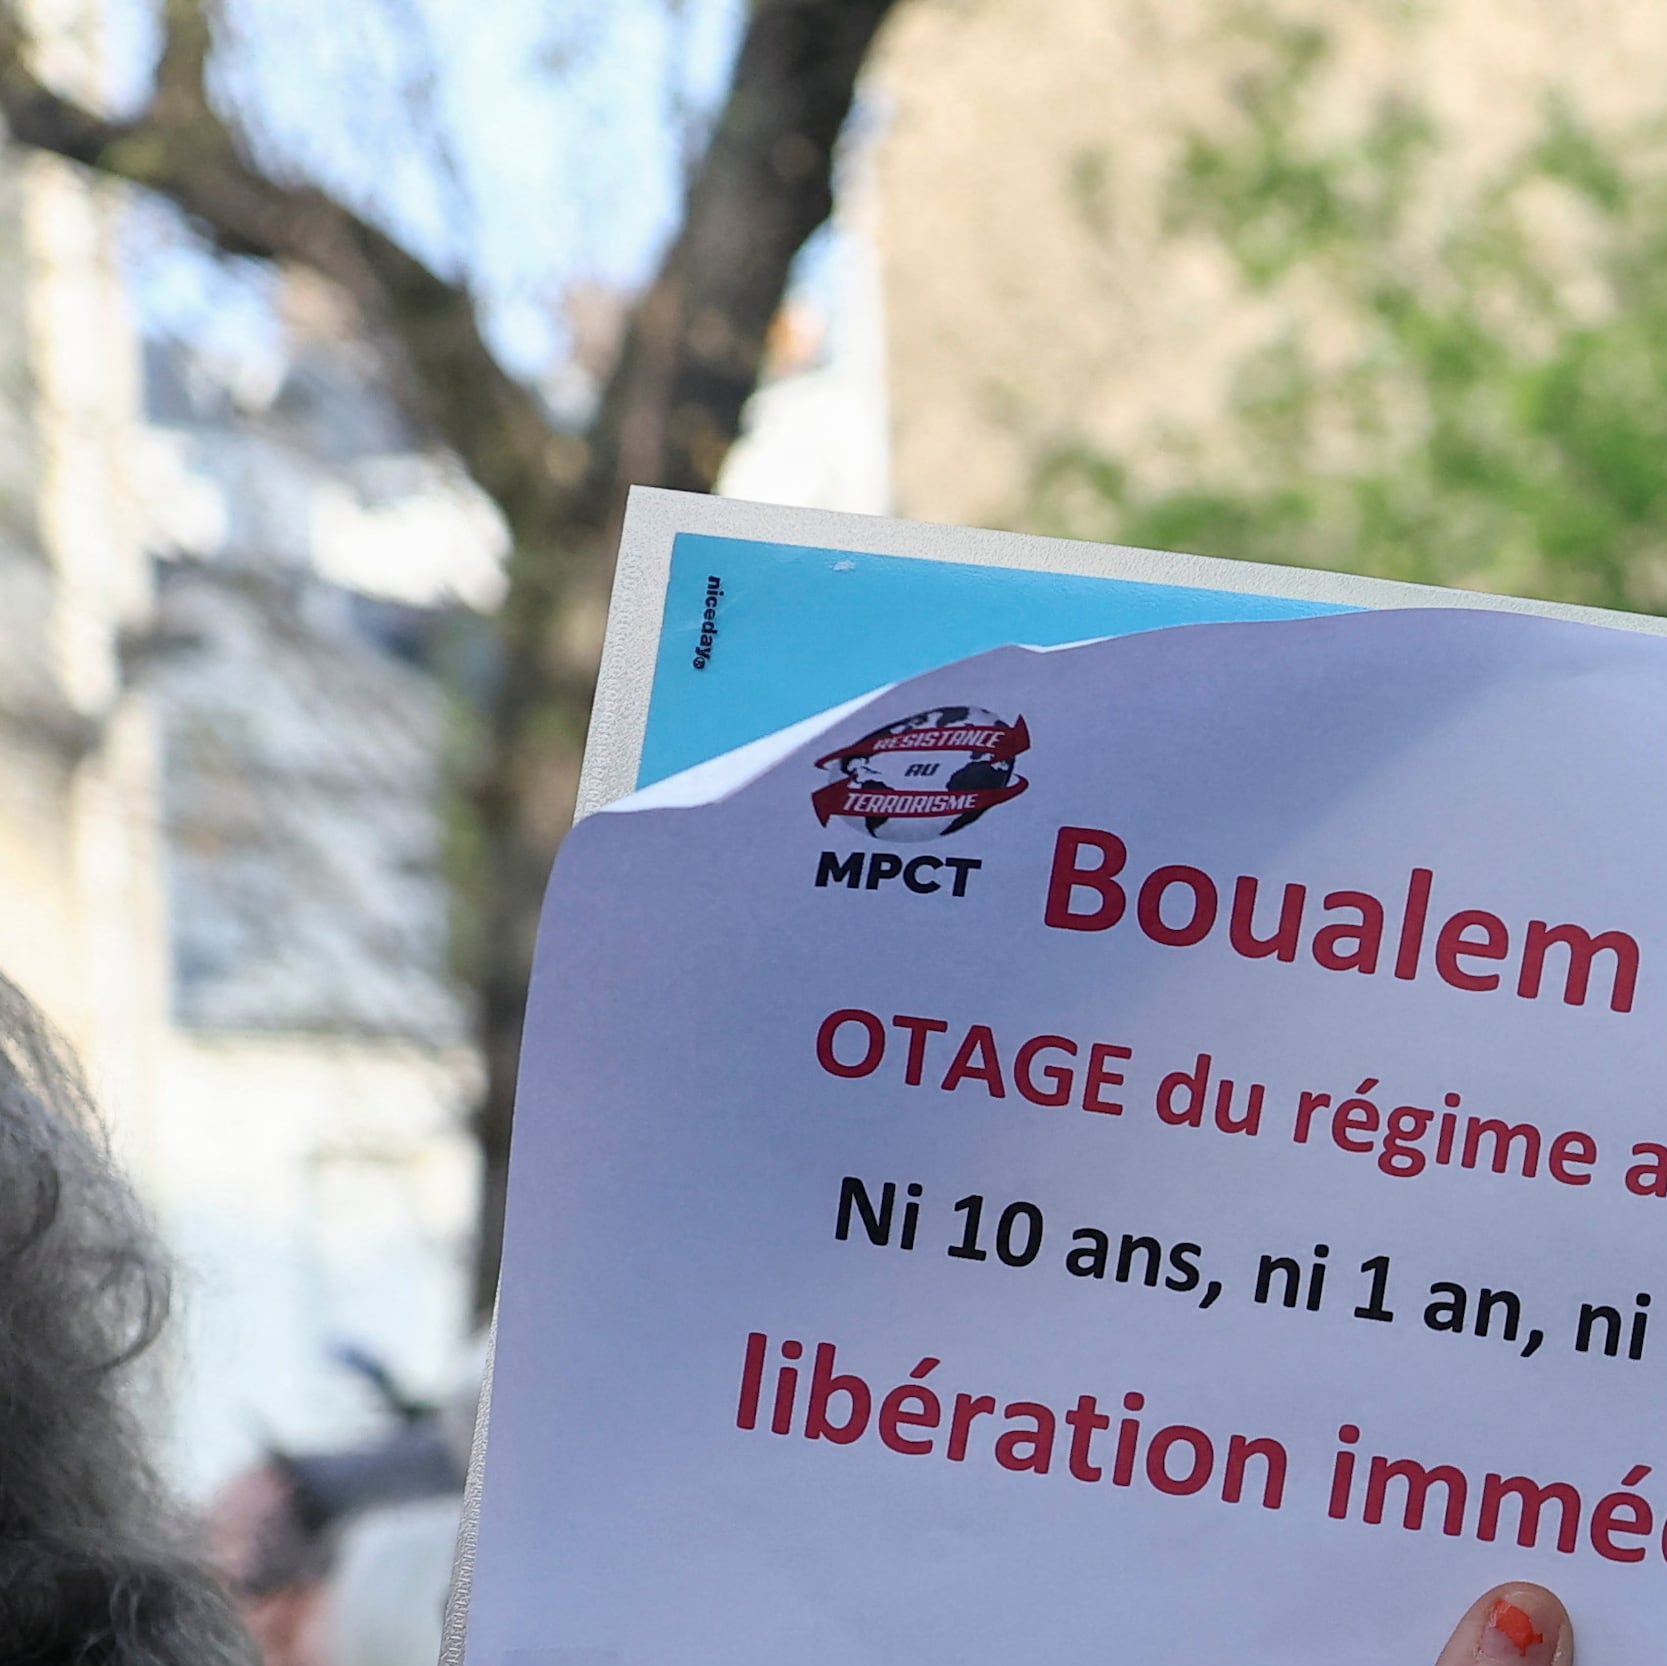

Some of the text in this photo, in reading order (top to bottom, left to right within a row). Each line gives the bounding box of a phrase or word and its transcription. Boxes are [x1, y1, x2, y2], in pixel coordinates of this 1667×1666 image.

[843, 792, 979, 813] TERRORISME
[904, 763, 941, 778] AU
[815, 851, 982, 897] MPCT
[1044, 826, 1639, 1013] Boualem
[817, 1009, 1132, 1116] OTAGE
[1156, 1051, 1265, 1136] du
[1293, 1078, 1597, 1185] régime
[835, 1177, 923, 1250] Ni
[948, 1195, 1043, 1267] 10
[1066, 1228, 1222, 1309] ans,
[1254, 1244, 1329, 1311] ni
[1354, 1256, 1393, 1322] 1
[1424, 1282, 1543, 1357] an,
[1575, 1293, 1651, 1360] ni
[736, 1332, 1287, 1509] libération
